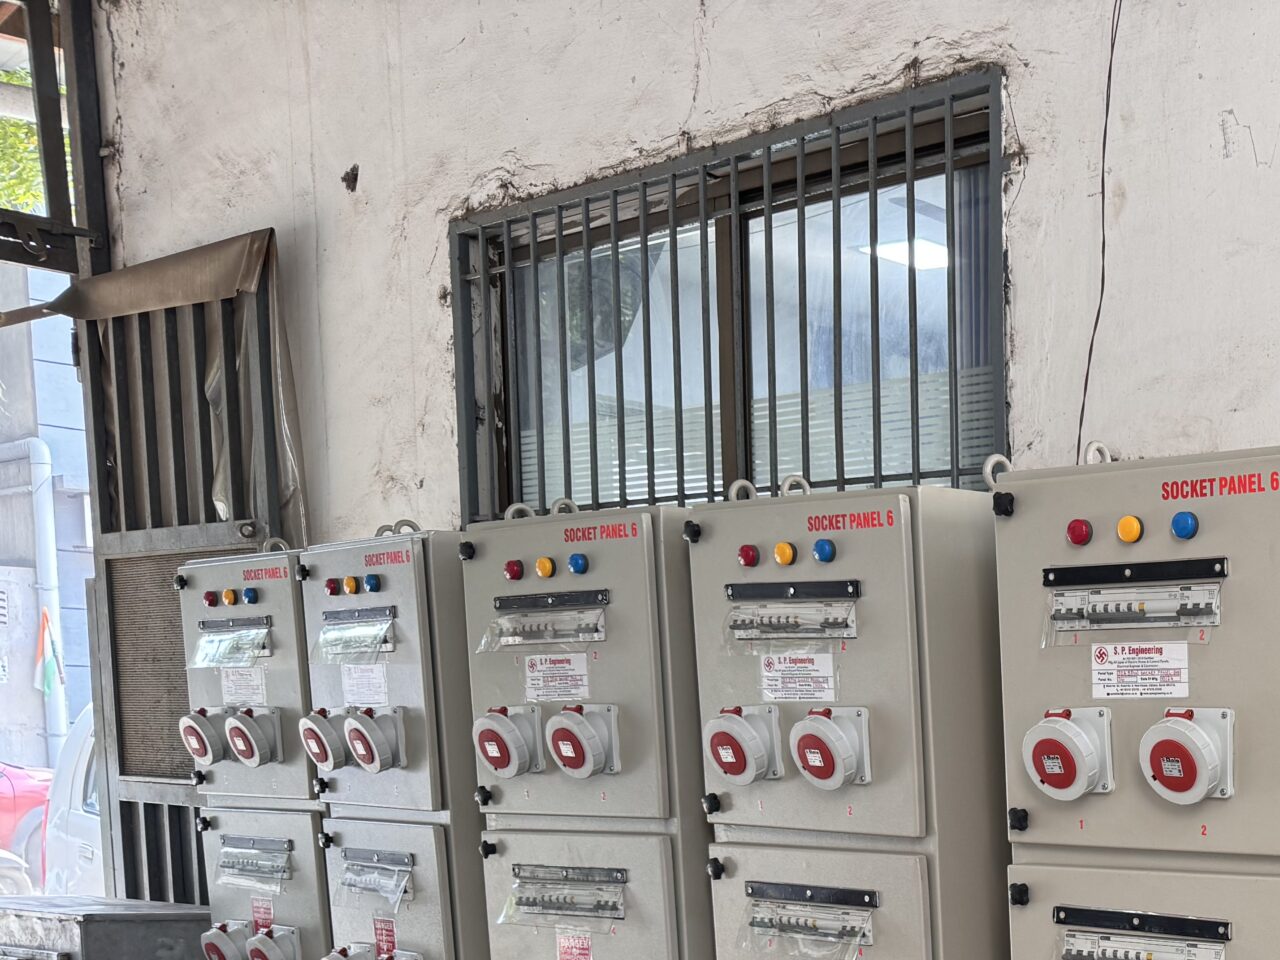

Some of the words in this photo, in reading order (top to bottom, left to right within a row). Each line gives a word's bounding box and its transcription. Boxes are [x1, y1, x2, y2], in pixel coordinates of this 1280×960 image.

[1162, 478, 1216, 500] SOCKET
[1219, 473, 1265, 495] PANEL
[1270, 471, 1280, 491] 6
[808, 514, 847, 532] SOCKET
[850, 511, 884, 529] PANEL
[887, 510, 894, 526] 6
[564, 527, 597, 542] SOCKET
[600, 523, 629, 539] PANEL
[631, 522, 637, 537] 6
[364, 552, 385, 567] SOCKET
[386, 550, 405, 564] PANEL
[406, 550, 410, 562] 6
[243, 568, 263, 581] SOCKET
[264, 566, 283, 579] PANEL
[284, 566, 288, 578] 6
[1073, 633, 1078, 644] 1
[1199, 629, 1205, 640] 2
[841, 642, 846, 651] 2
[1114, 646, 1120, 655] S.
[1121, 646, 1127, 655] P.
[1128, 646, 1163, 656] Engineering
[1079, 819, 1084, 830] 1
[1201, 825, 1207, 836] 2
